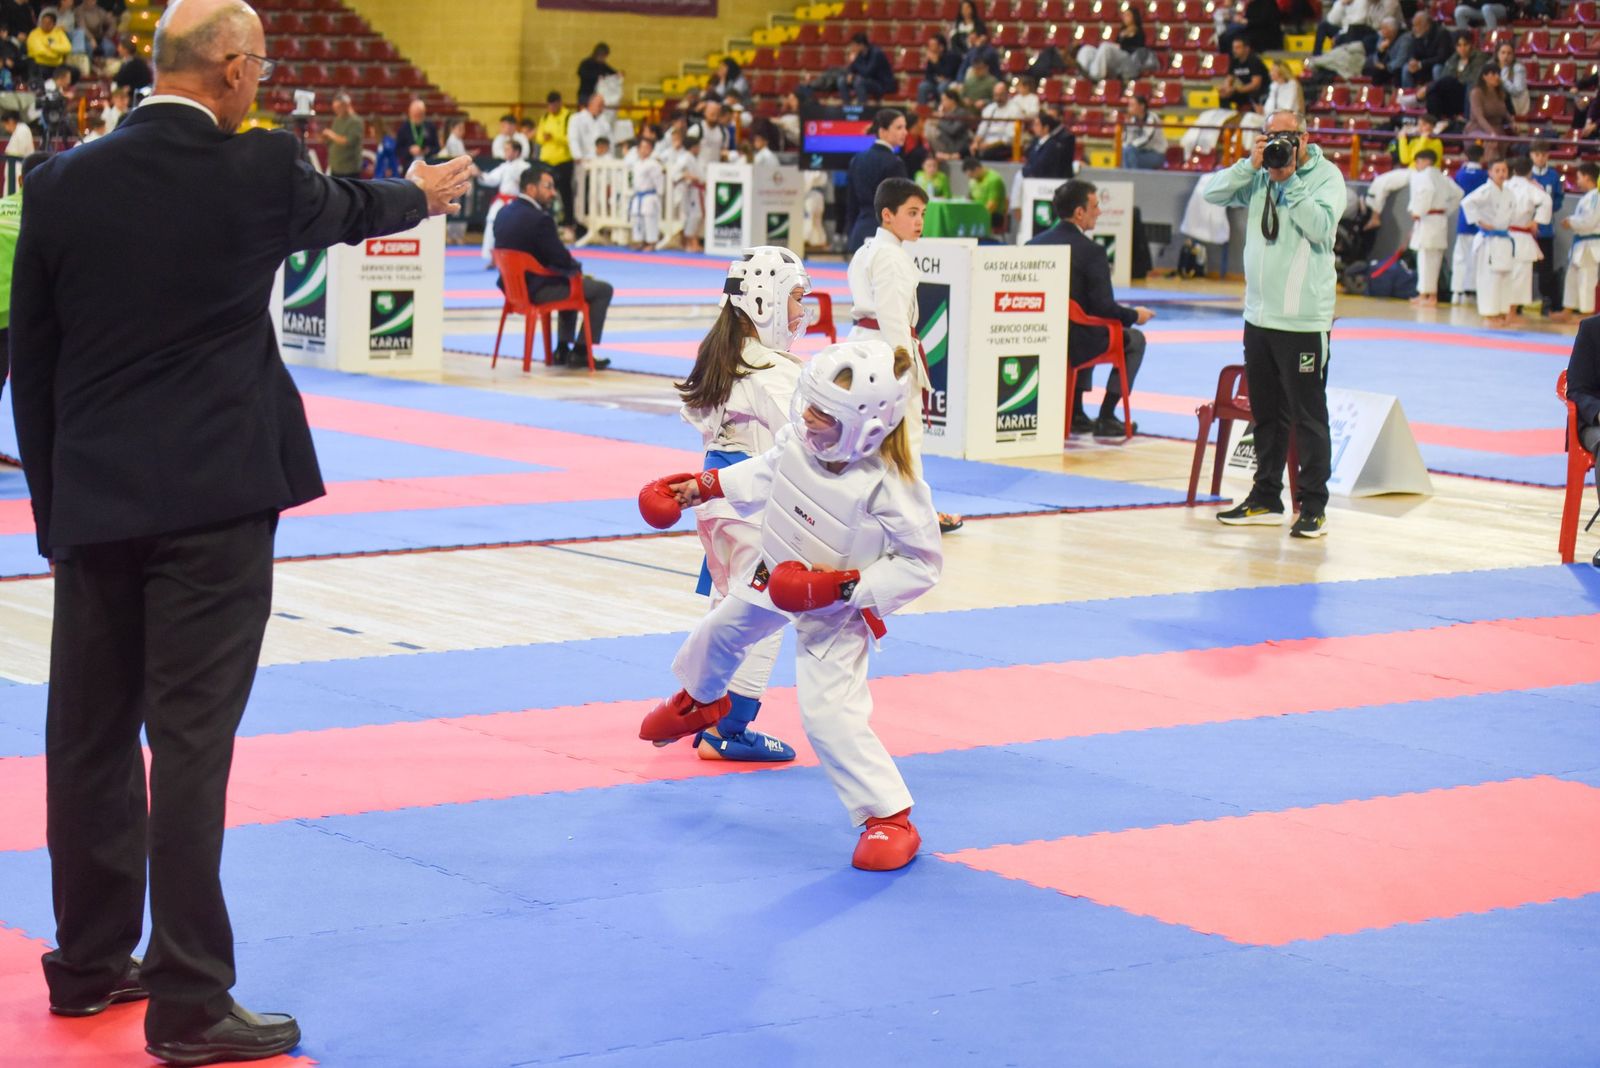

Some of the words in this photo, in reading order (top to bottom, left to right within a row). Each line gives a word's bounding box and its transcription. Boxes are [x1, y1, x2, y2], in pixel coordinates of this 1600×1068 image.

[384, 242, 417, 253] CEPSA
[983, 261, 998, 270] GAS
[999, 261, 1008, 270] DE
[1009, 260, 1019, 270] LA
[1011, 296, 1042, 309] CEPSA
[282, 311, 326, 338] KARATE
[990, 324, 1022, 334] SERVICIO
[1022, 323, 1048, 333] OFICIAL
[370, 335, 412, 349] KARATE
[997, 414, 1037, 430] KARATE
[794, 505, 815, 526] SMAI
